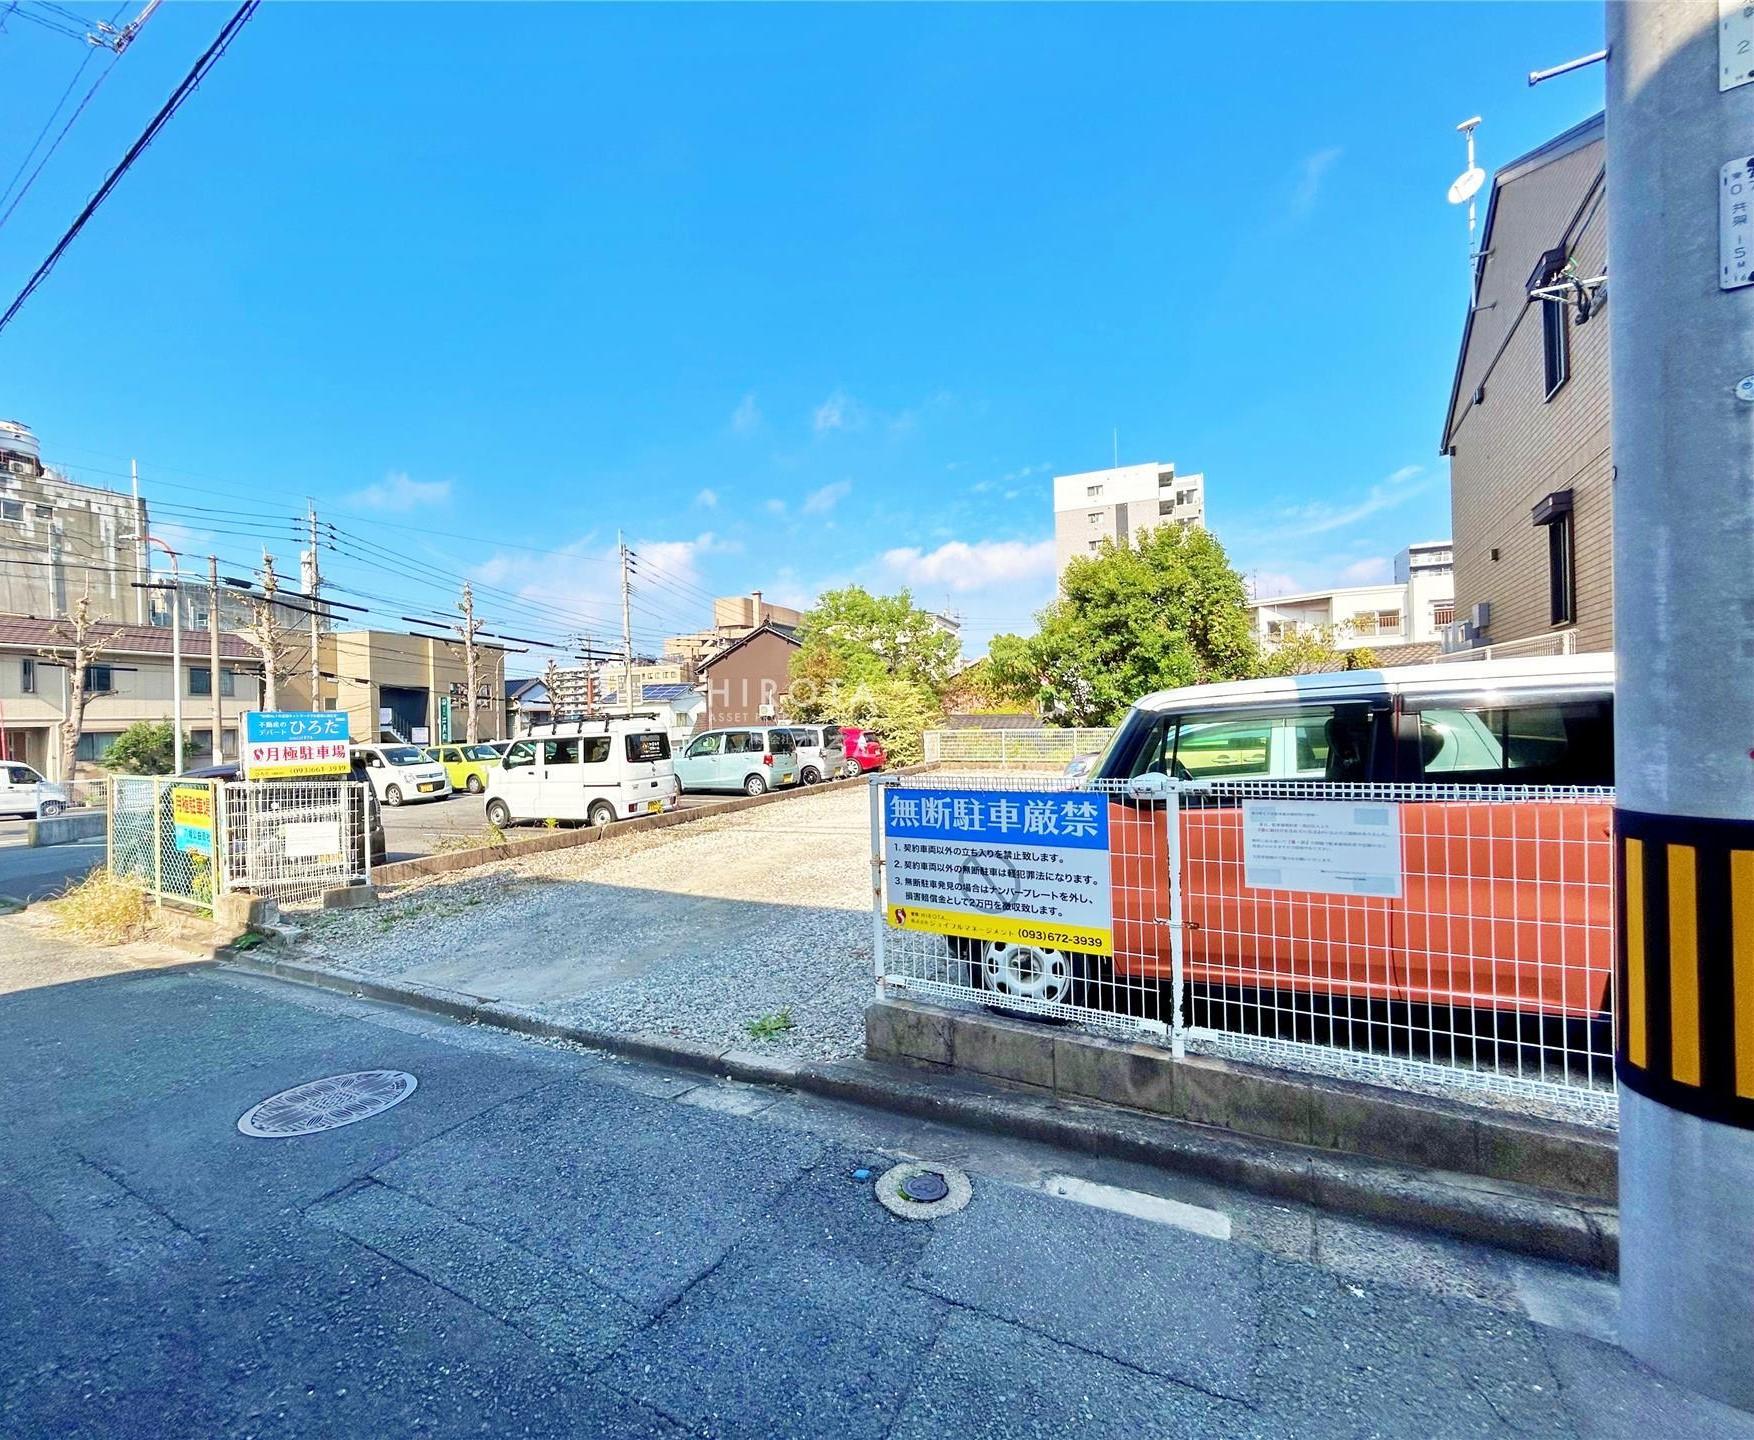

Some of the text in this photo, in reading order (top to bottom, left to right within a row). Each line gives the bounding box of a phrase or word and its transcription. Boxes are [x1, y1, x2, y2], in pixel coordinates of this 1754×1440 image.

[289, 719, 339, 735] ひろた
[266, 744, 346, 762] 月極駐車場
[889, 795, 1099, 837] 無断駐車厳禁
[904, 844, 1064, 864] 契約車両以外の立ち入りを禁止致します。
[904, 861, 1098, 886] 契約車両以外の無断駐車は軽犯罪法になります。
[904, 877, 1094, 905] 無断駐車発見の場合はナンバープレートを外し、
[905, 891, 1063, 917] 損害賠償金として2万円を徴収致します。
[1018, 928, 1103, 948] (093)672-3939
